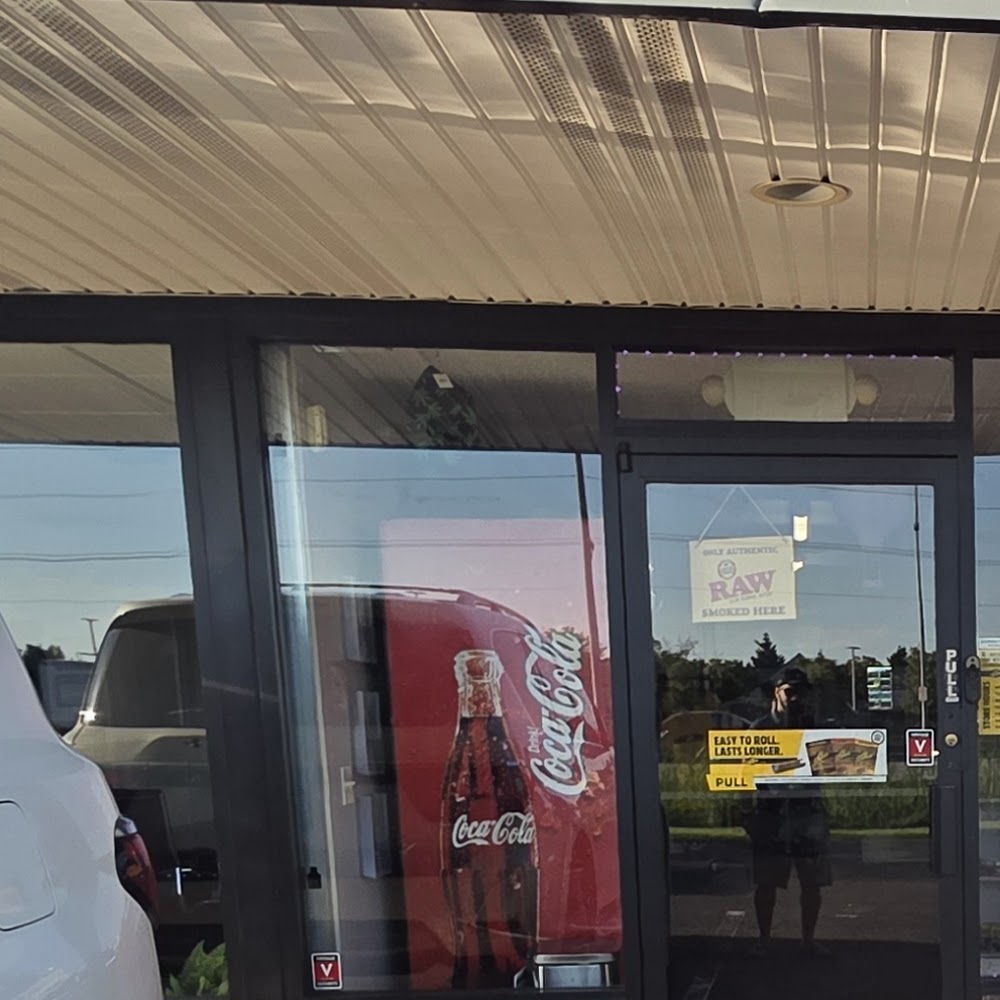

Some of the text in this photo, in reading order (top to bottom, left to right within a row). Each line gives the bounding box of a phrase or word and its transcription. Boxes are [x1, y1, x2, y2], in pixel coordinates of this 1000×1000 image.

[725, 546, 779, 556] AUTHENTIC
[708, 569, 776, 603] RAW
[702, 605, 786, 617] SMOKED HERE
[945, 649, 958, 698] PULL
[524, 623, 588, 796] Coca-Cola
[714, 735, 780, 746] EASY TO ROLL.
[914, 739, 927, 753] V
[714, 746, 783, 757] LASTS LONGER.
[716, 777, 748, 787] PULL
[452, 812, 536, 848] Coca-Cola
[320, 963, 333, 977] V
